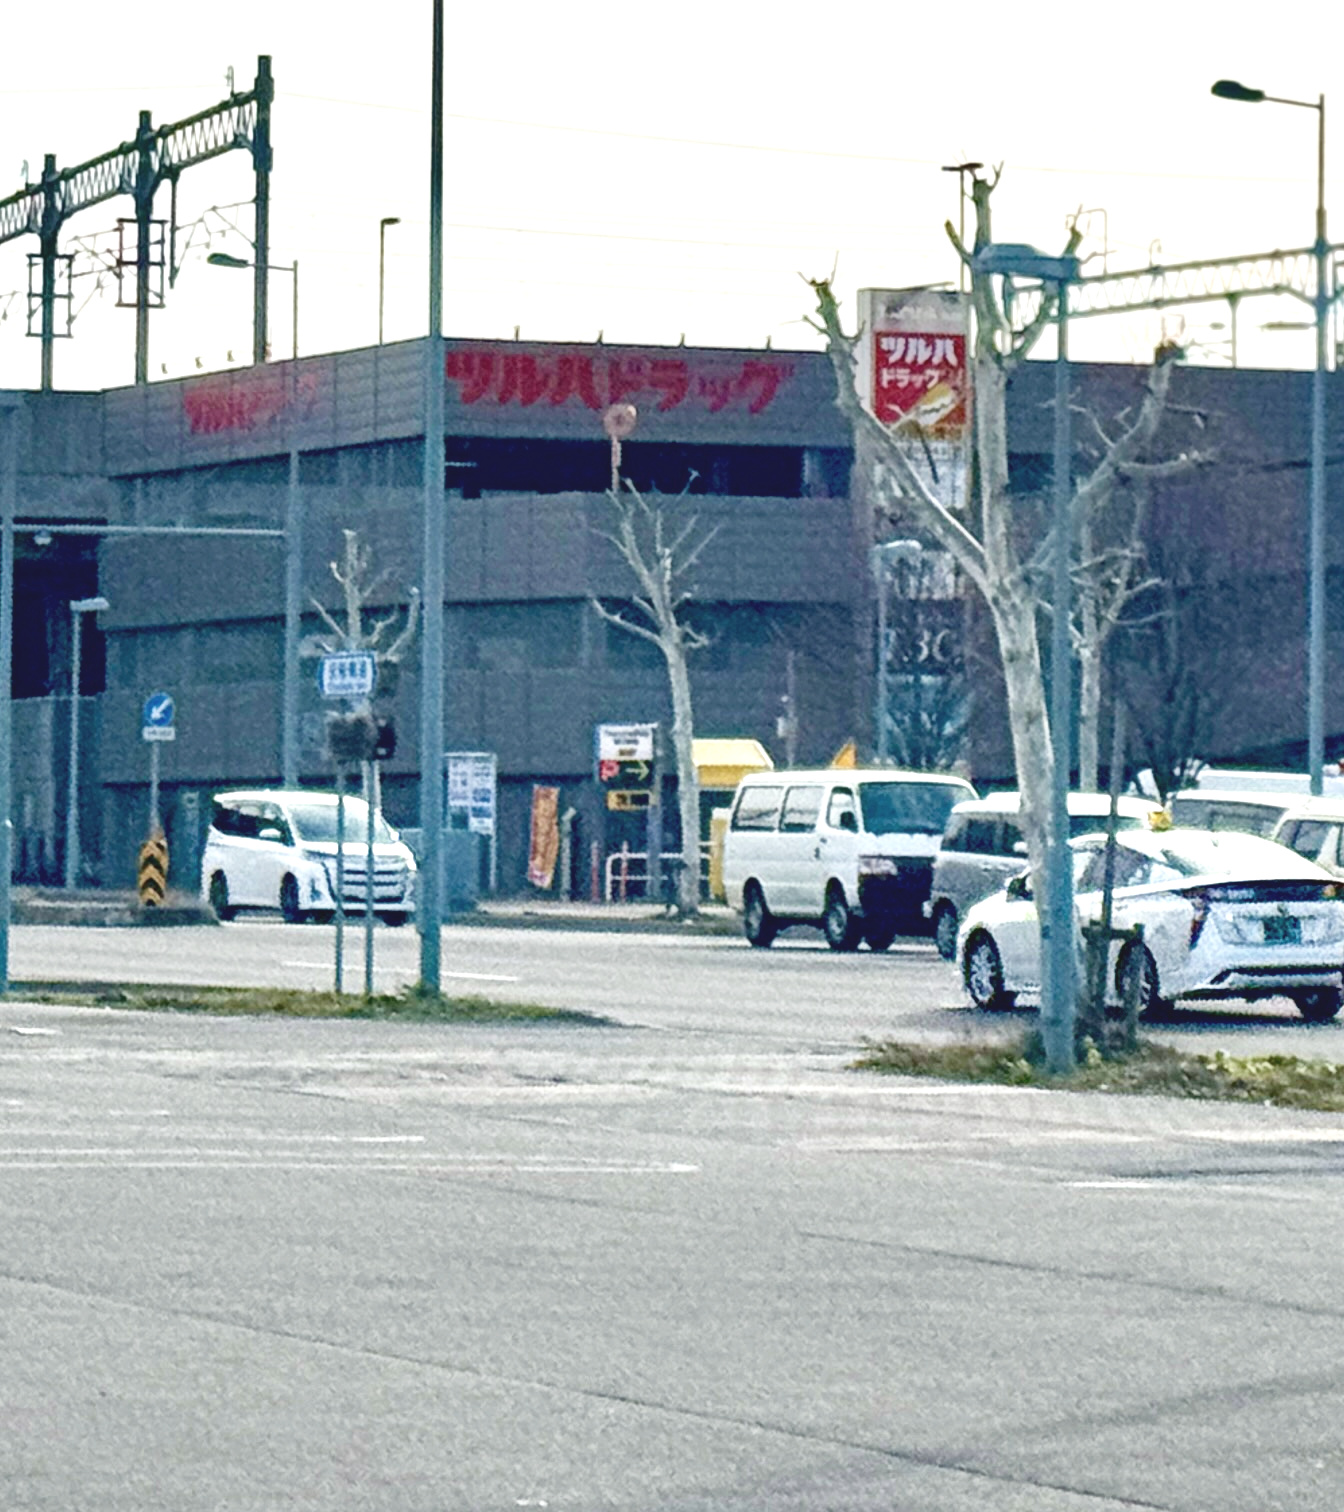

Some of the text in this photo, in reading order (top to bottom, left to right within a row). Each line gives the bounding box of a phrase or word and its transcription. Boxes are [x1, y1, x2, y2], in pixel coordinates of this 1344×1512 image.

[880, 337, 958, 366] ツルハ
[446, 351, 795, 414] ツルハドラッグ
